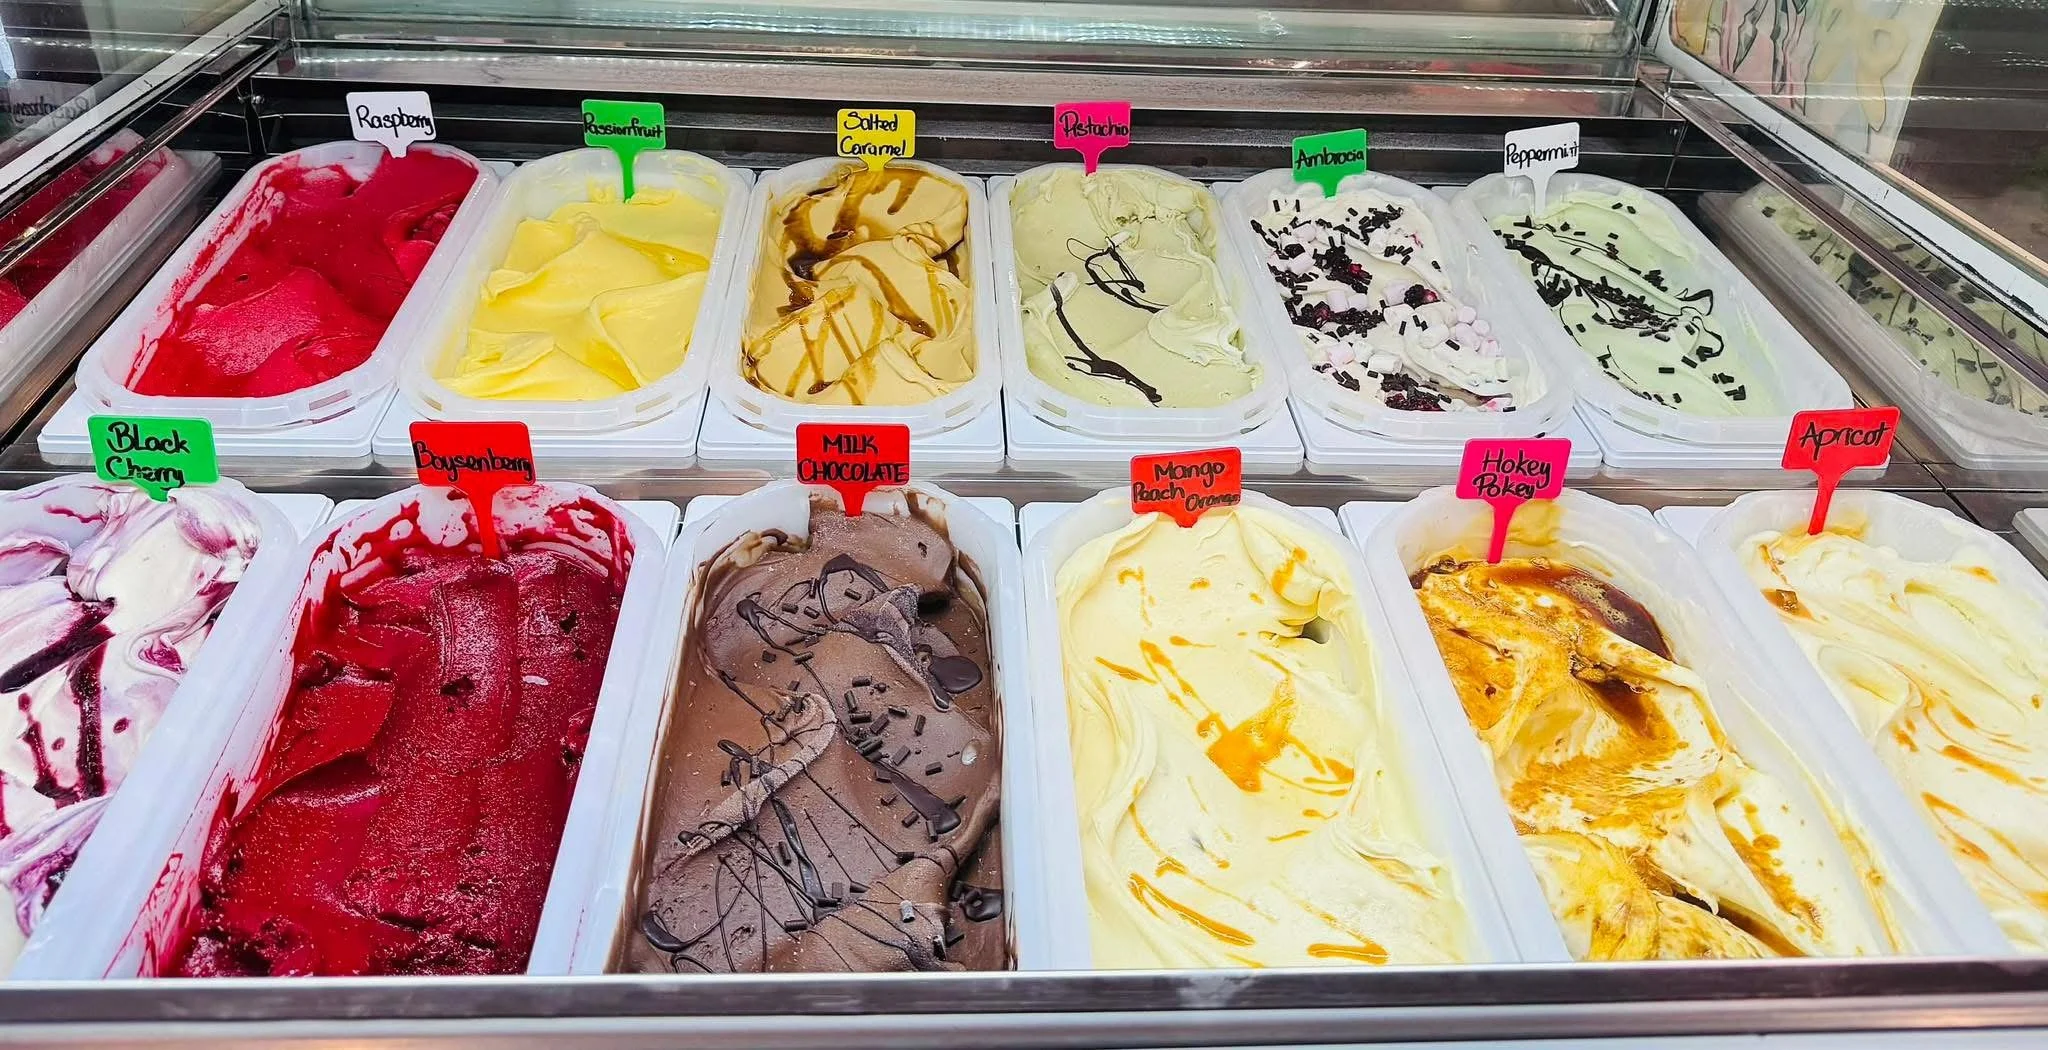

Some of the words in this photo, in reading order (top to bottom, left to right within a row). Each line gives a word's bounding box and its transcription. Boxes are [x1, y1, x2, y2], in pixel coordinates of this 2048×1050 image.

[355, 104, 434, 138] Raspberry
[584, 111, 663, 138] Passionfruit
[844, 111, 898, 132] Salted
[1059, 110, 1129, 138] Pistachio
[839, 134, 906, 157] Caramel
[1294, 147, 1364, 169] Ambrocia
[1506, 140, 1579, 169] Peppermint
[822, 433, 878, 456] MILK
[1800, 421, 1889, 462] Apricot
[105, 456, 185, 489] Cherry
[412, 440, 534, 483] Boysenberry
[797, 458, 910, 484] CHOCOLATE
[1154, 461, 1225, 488] Mango
[1482, 448, 1551, 489] Hokey
[1133, 480, 1185, 503] Peach
[1473, 475, 1535, 499] Pokey
